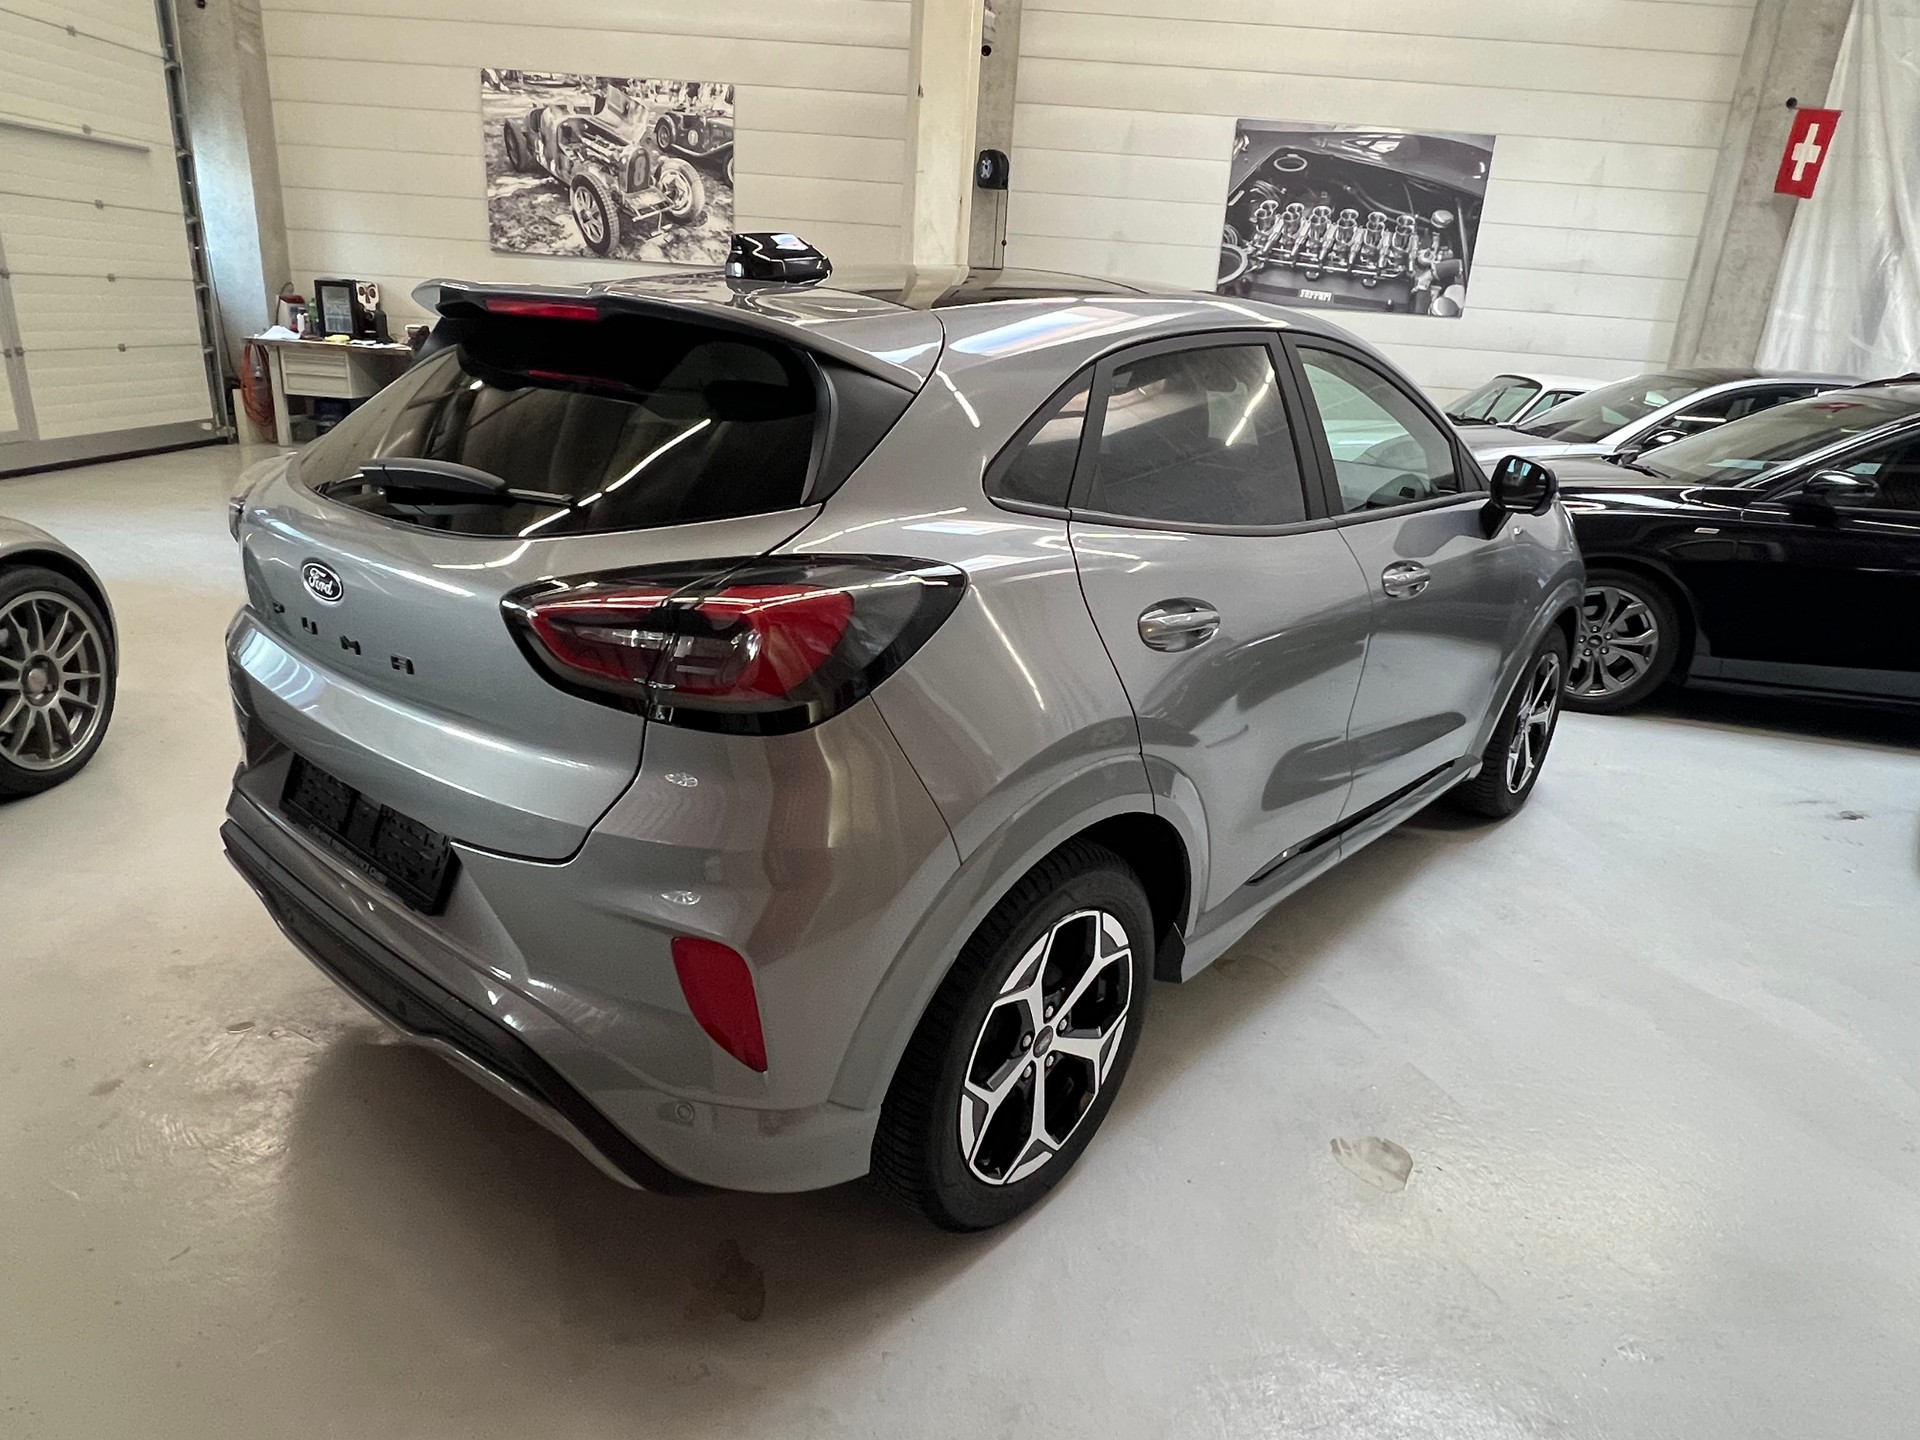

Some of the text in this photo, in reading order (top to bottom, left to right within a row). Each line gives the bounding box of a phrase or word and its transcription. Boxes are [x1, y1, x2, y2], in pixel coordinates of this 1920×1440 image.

[1300, 289, 1332, 301] Ferrari
[308, 567, 334, 596] Ford
[271, 602, 415, 675] PUMA
